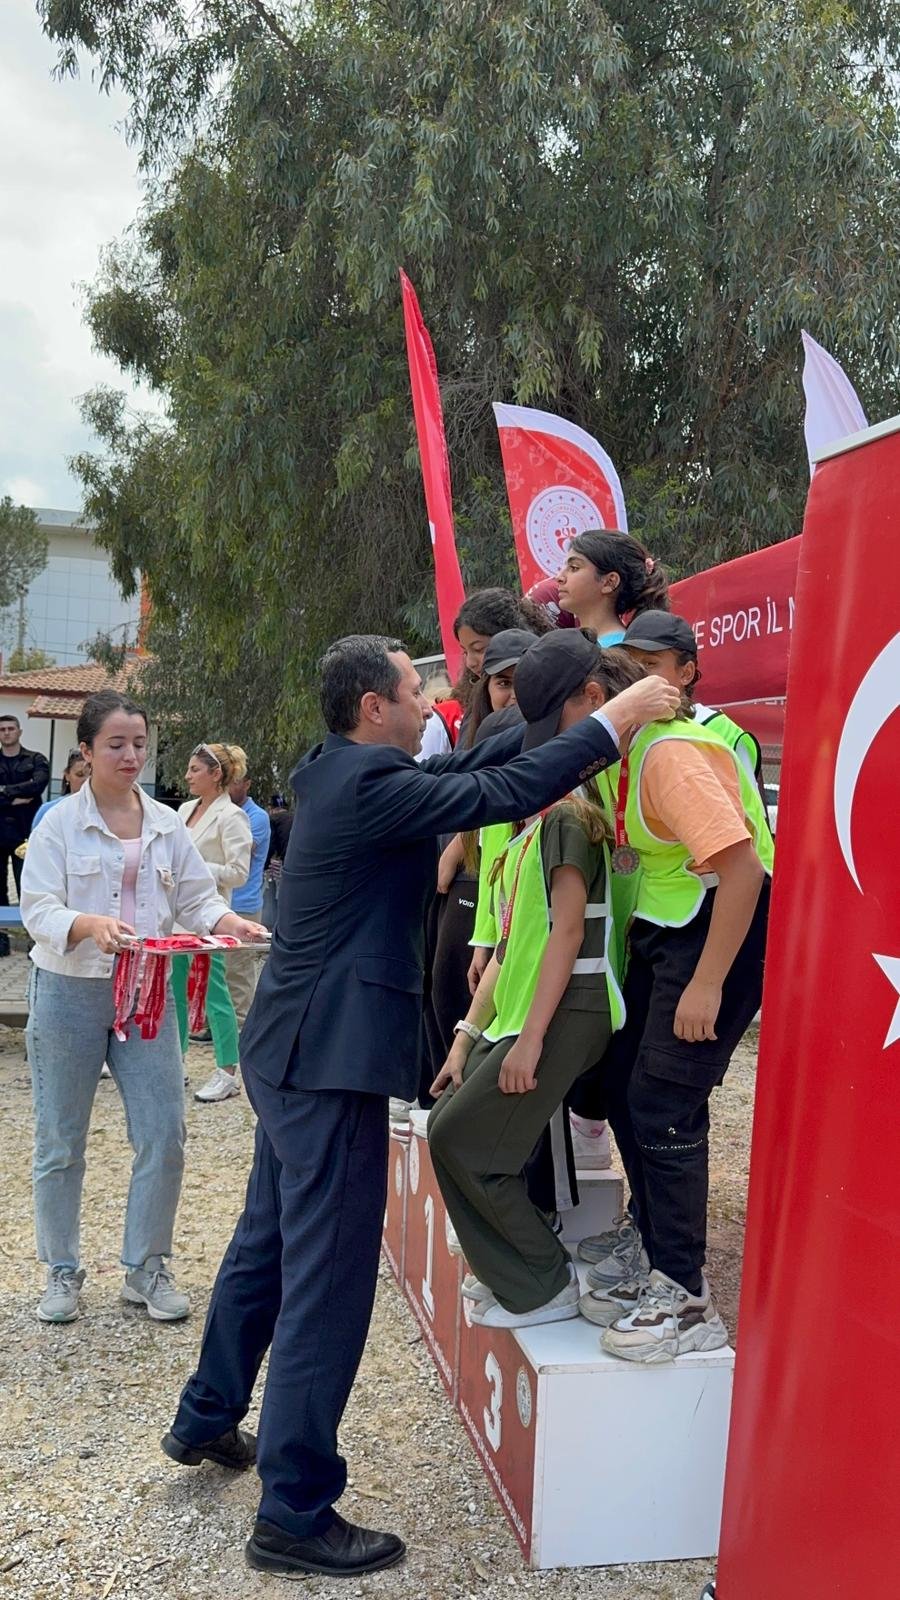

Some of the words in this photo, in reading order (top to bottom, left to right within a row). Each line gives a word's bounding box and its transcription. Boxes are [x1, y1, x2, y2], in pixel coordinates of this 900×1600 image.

[710, 607, 760, 647] SPOR
[767, 596, 783, 634] İL
[458, 898, 475, 908] VOID
[422, 1194, 435, 1323] 1
[483, 1350, 504, 1453] 3
